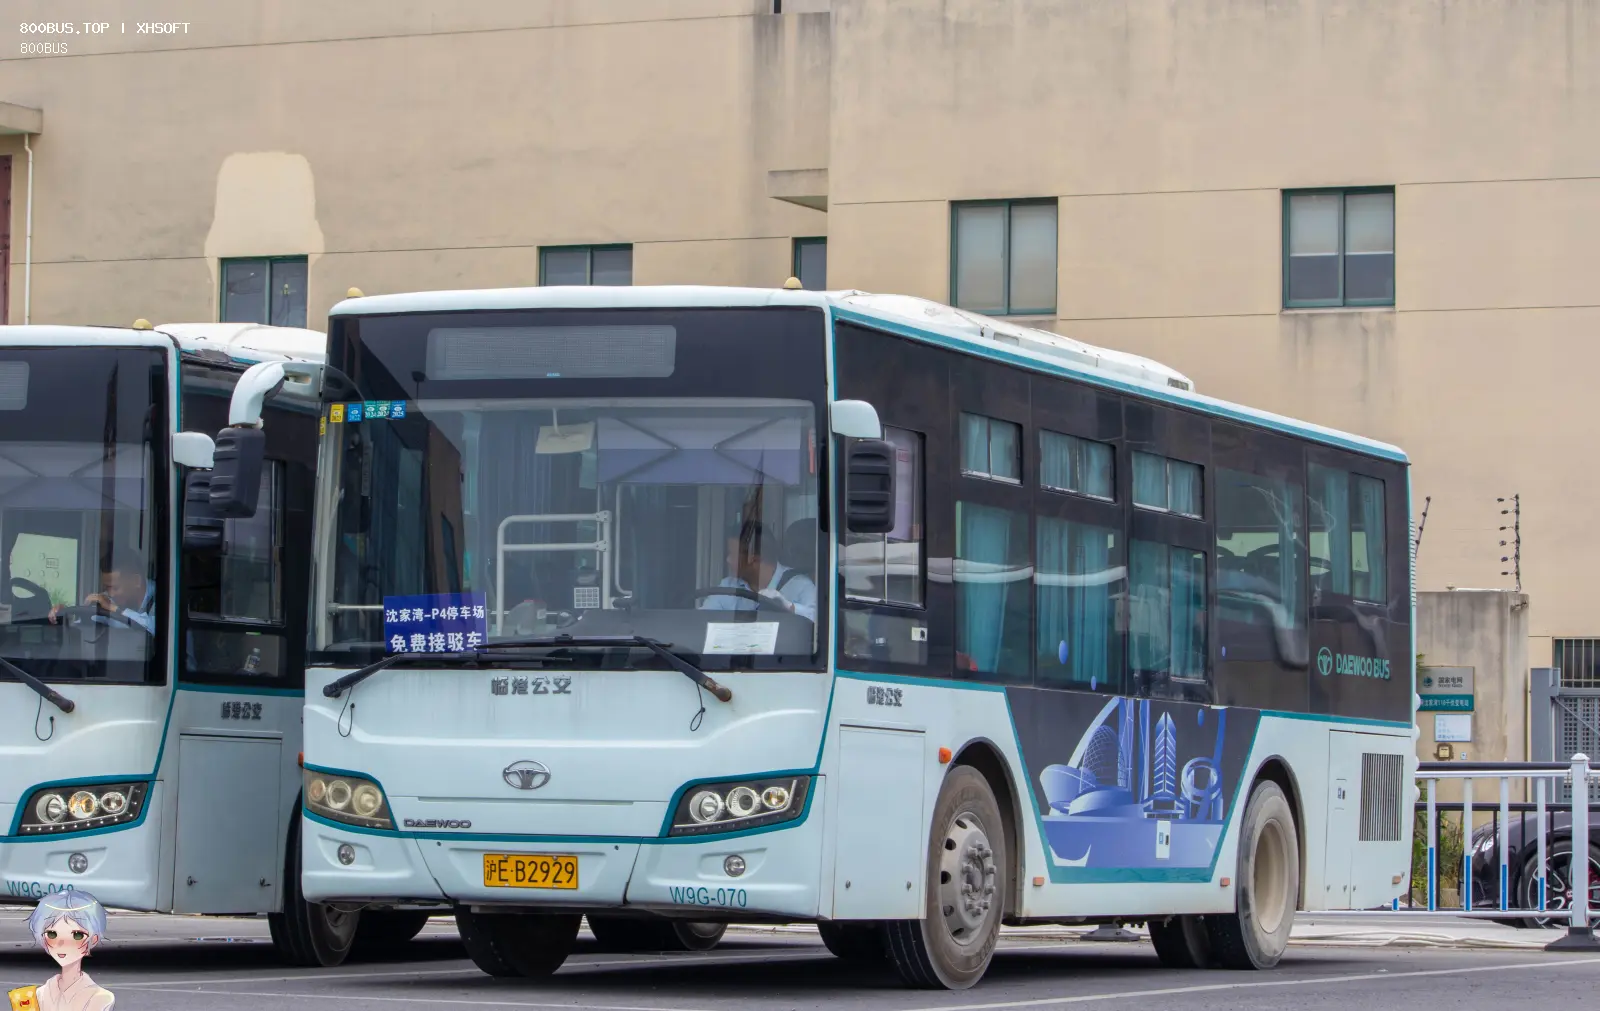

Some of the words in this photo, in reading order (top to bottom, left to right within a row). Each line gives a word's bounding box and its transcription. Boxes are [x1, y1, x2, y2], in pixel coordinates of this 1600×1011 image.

[386, 605, 485, 623] 沈家湾-P4停车场
[390, 631, 482, 653] 免费接驳车
[1335, 653, 1372, 677] DAEWOO
[1373, 657, 1390, 680] BUS
[491, 674, 572, 696] 临港公交
[404, 818, 472, 829] DAEWOO
[669, 886, 747, 907] W9G-070
